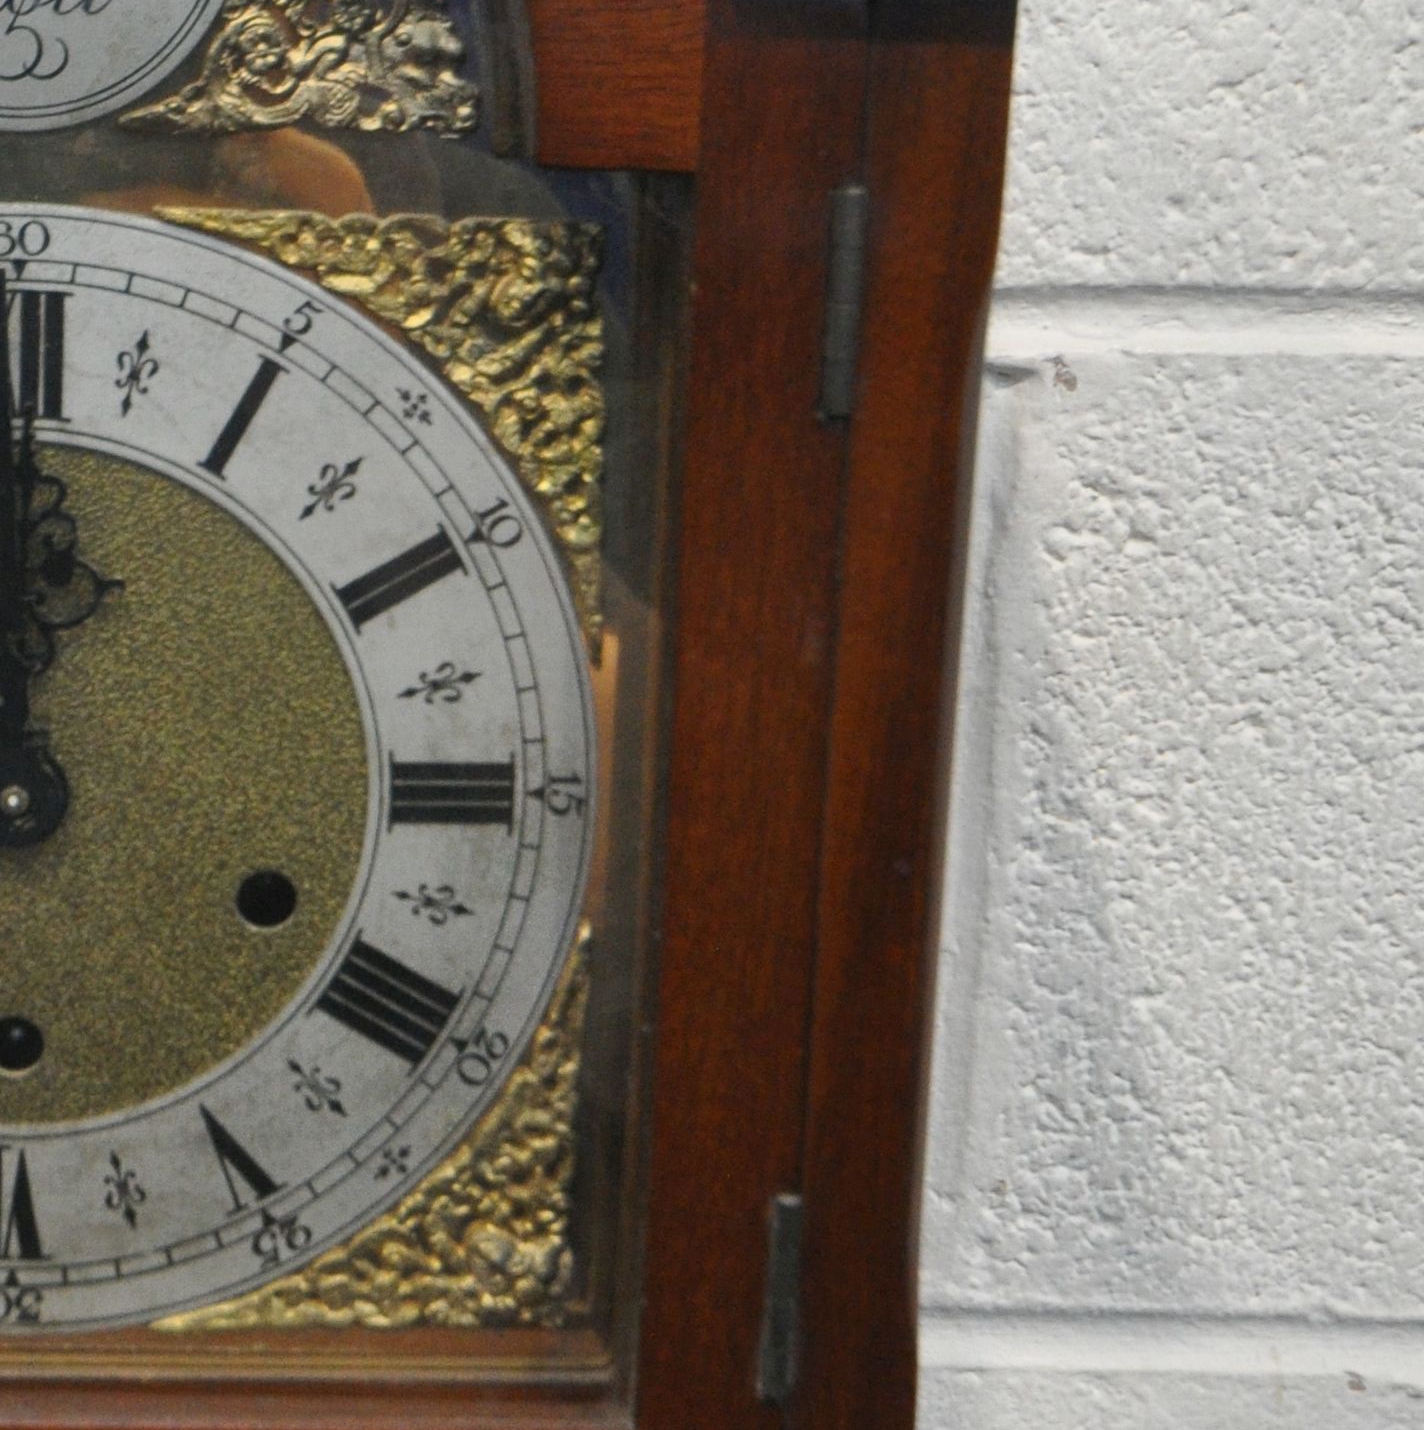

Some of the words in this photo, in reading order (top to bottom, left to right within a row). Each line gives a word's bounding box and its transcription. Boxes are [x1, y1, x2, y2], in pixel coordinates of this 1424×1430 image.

[283, 300, 326, 337] 5
[477, 497, 523, 549] 10
[329, 522, 469, 637] II
[387, 751, 516, 837] III
[547, 773, 587, 818] 15
[306, 928, 465, 1077] IIII
[456, 1029, 510, 1088] 20
[198, 1103, 289, 1216] V
[251, 1216, 313, 1269] 25
